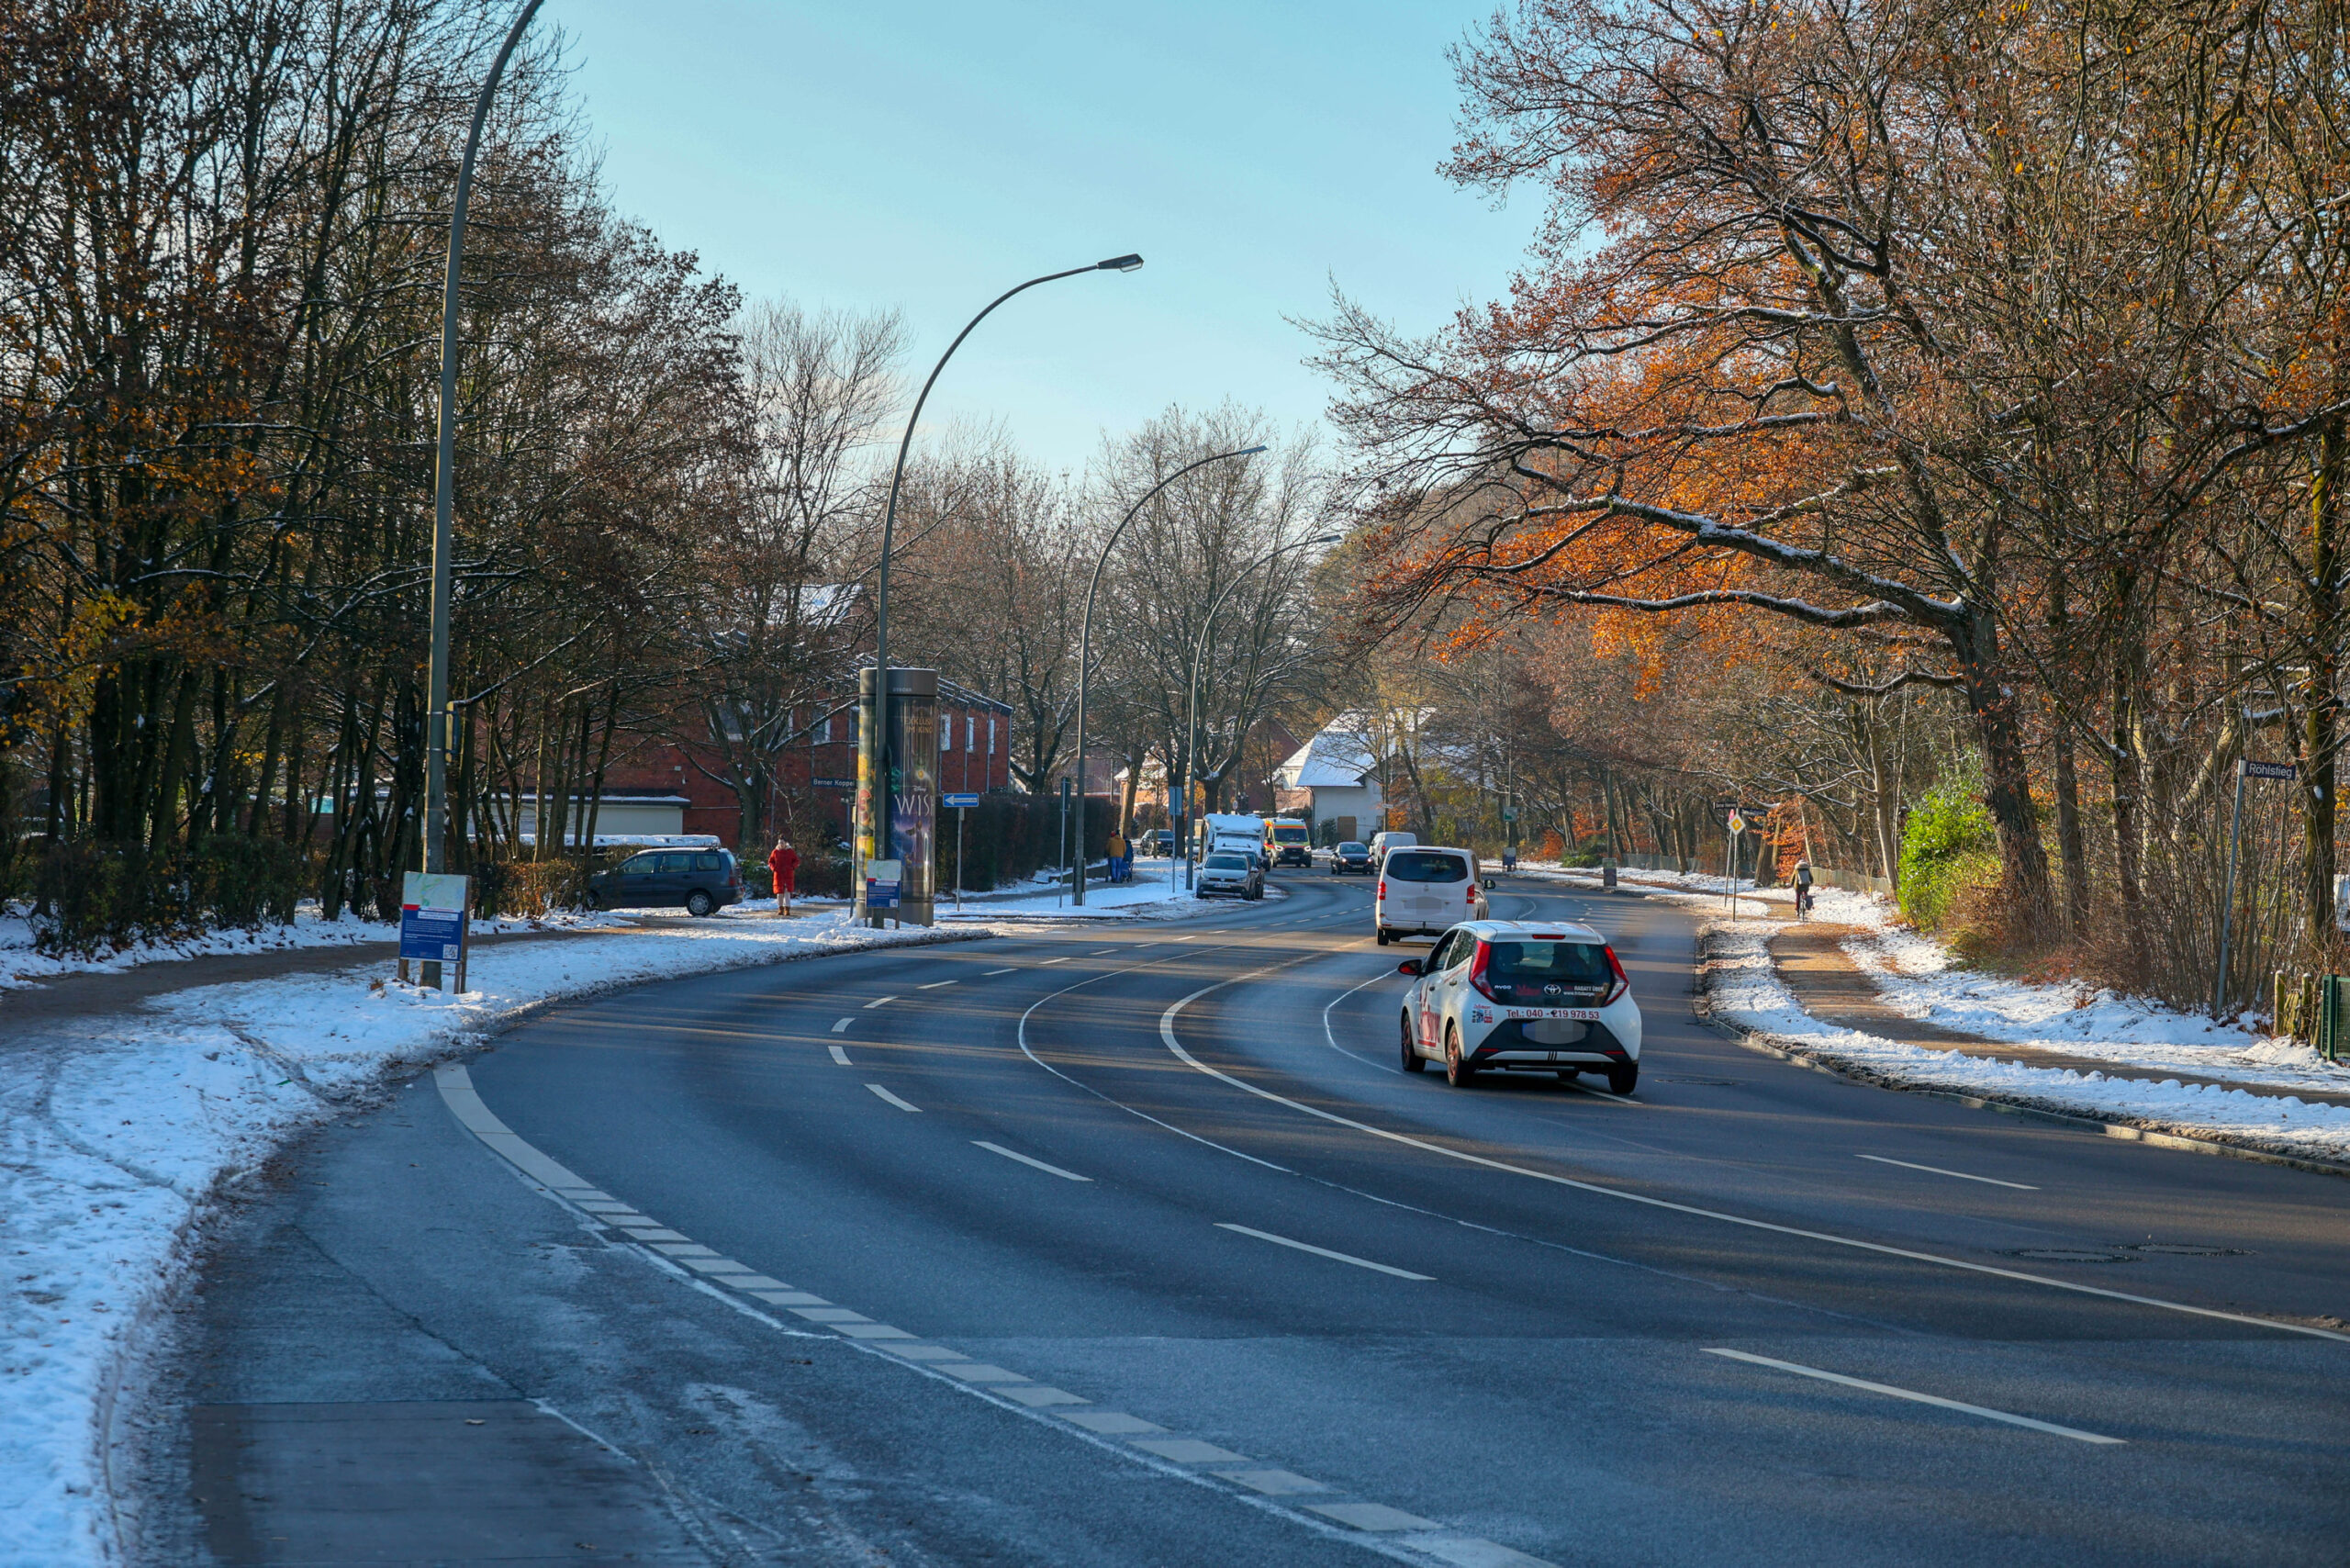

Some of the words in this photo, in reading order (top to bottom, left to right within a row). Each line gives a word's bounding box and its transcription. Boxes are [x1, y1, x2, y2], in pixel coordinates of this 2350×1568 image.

[2249, 763, 2292, 779] Röhlstieg
[813, 778, 833, 786] Berner
[834, 778, 856, 788] Koppel
[1506, 1009, 1524, 1018] Tel.:
[1526, 1009, 1543, 1018] 040
[1571, 1010, 1586, 1019] 978
[1588, 1011, 1600, 1020] 53
